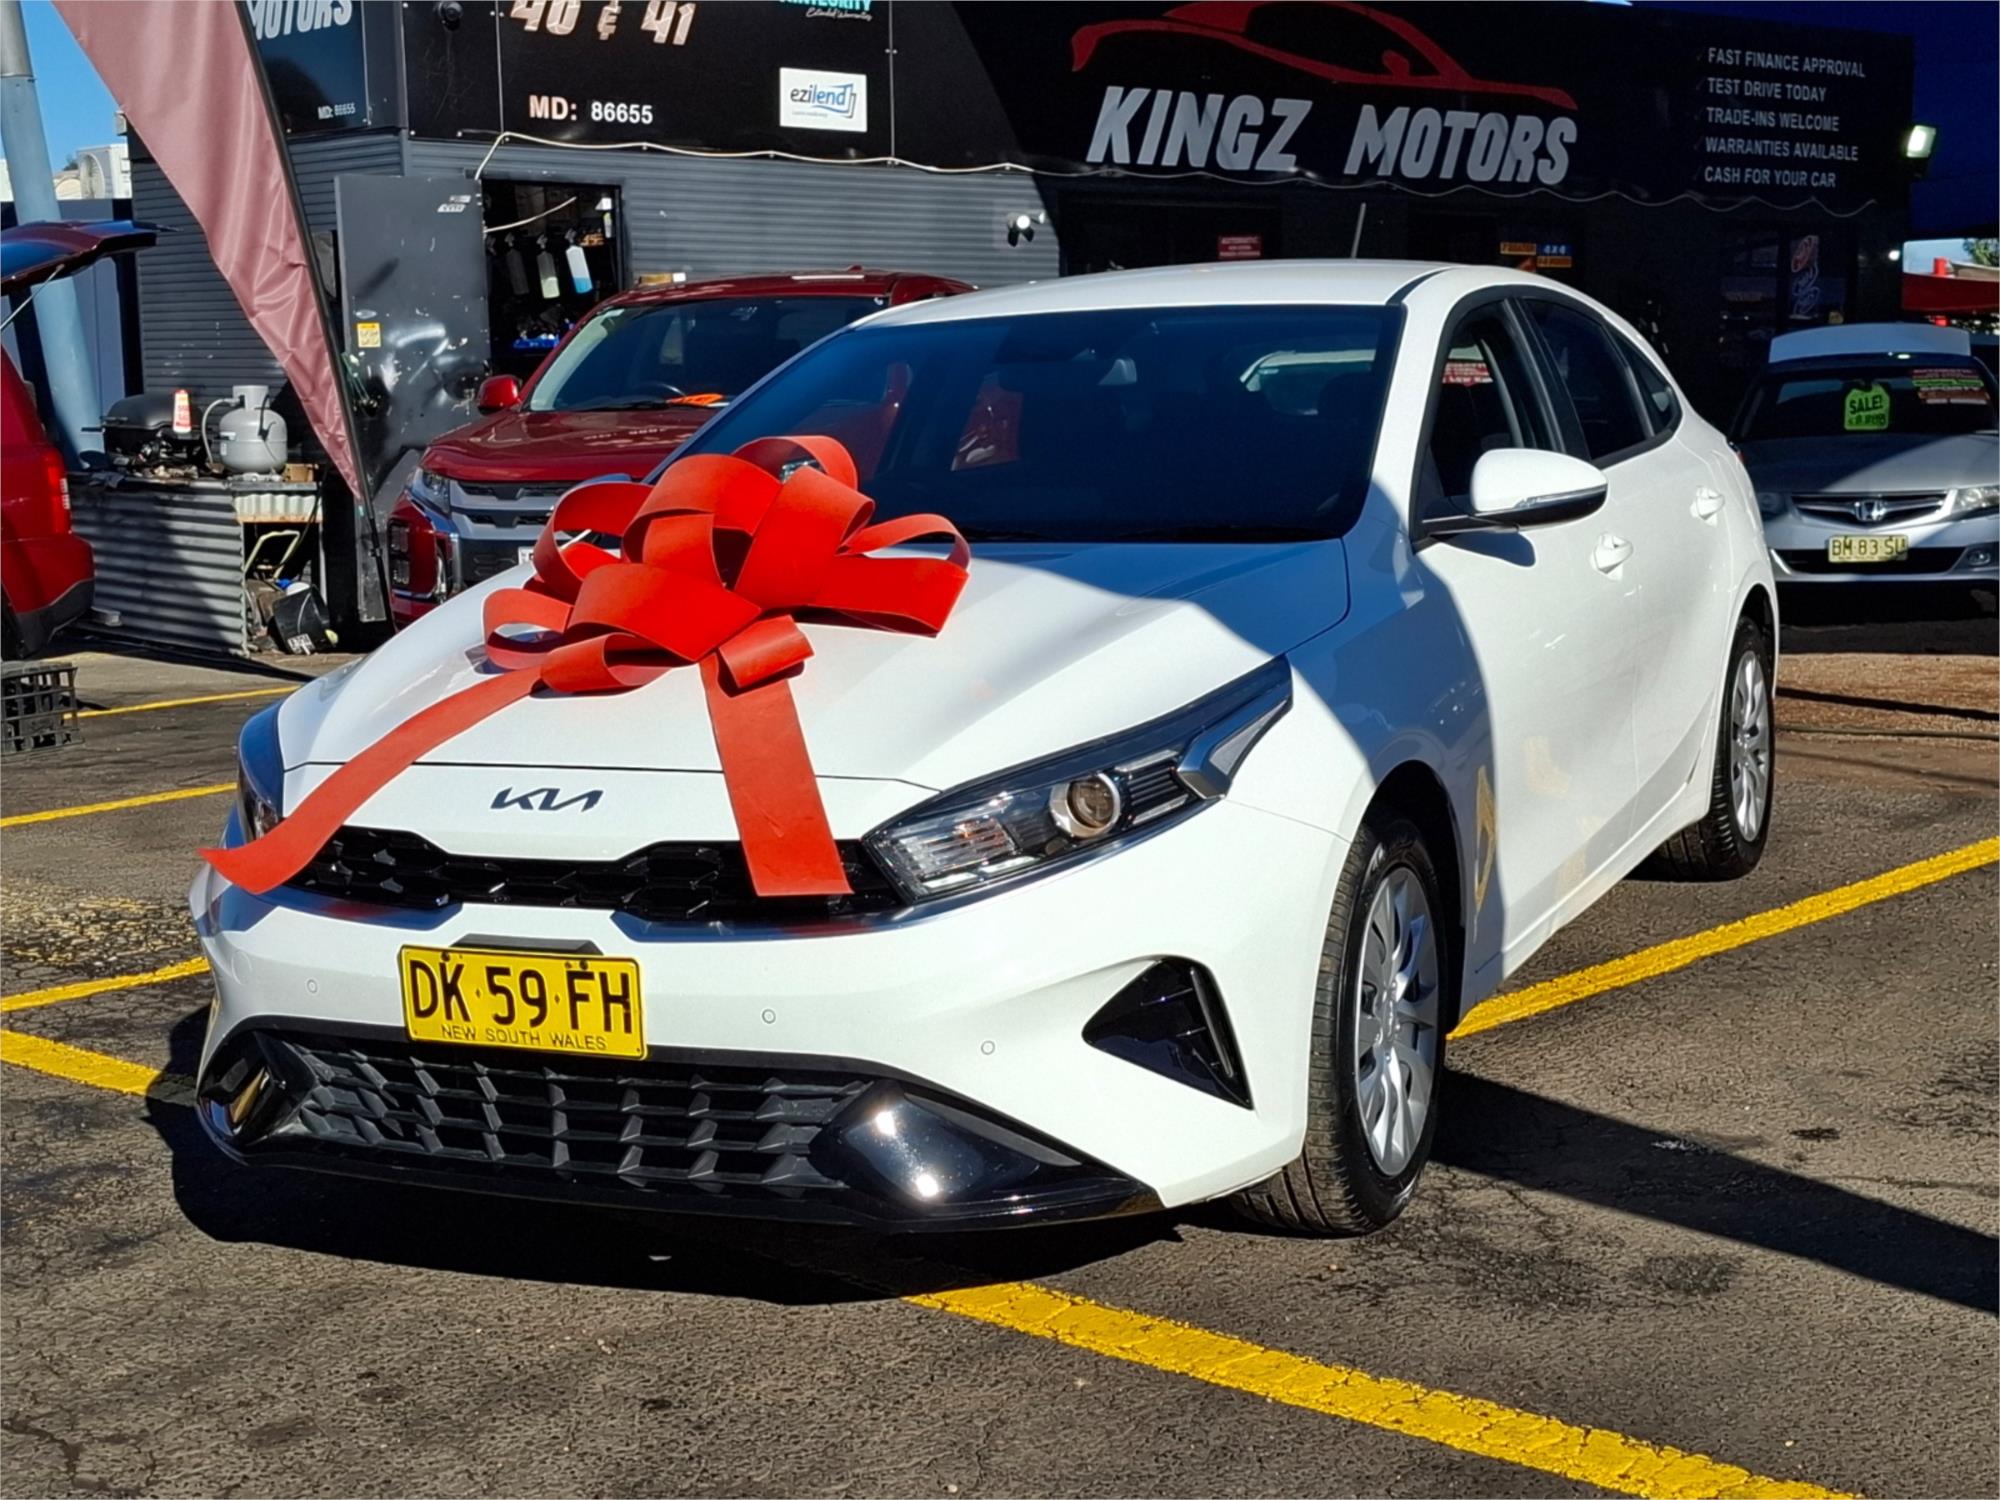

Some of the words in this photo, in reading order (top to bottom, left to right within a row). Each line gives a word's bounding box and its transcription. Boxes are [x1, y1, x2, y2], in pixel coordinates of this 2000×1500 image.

[510, 0, 581, 35] 40
[640, 1, 696, 46] 41
[1708, 47, 1741, 66] FAST
[1745, 51, 1799, 72] FINANCE
[1803, 56, 1866, 78] APPROVAL
[790, 83, 847, 106] ezilend
[1707, 77, 1741, 95] TEST
[1744, 80, 1782, 99] DRIVE
[1785, 83, 1827, 102] TODAY
[529, 94, 577, 120] MD:
[591, 101, 653, 124] 86655
[1706, 106, 1776, 128] TRADE-INS
[1779, 112, 1840, 132] WELCOME
[1086, 85, 1313, 171] KINGZ
[1343, 104, 1578, 185] MOTORS
[1705, 136, 1790, 157] WARRANTIES
[1793, 141, 1859, 161] AVAILABLE
[1704, 166, 1741, 183] CASH
[1744, 167, 1771, 185] FOR
[1774, 169, 1808, 187] YOUR
[1811, 171, 1837, 187] CAR
[1832, 538, 1853, 556] BM
[1858, 539, 1879, 556] 83
[1884, 537, 1905, 556] SU
[490, 786, 604, 813] KIA
[409, 959, 471, 1023] DK
[485, 965, 548, 1028] 59
[566, 970, 632, 1034] FH
[442, 1023, 477, 1041] NEW
[485, 1027, 541, 1047] SOUTH
[550, 1032, 607, 1051] WALES
